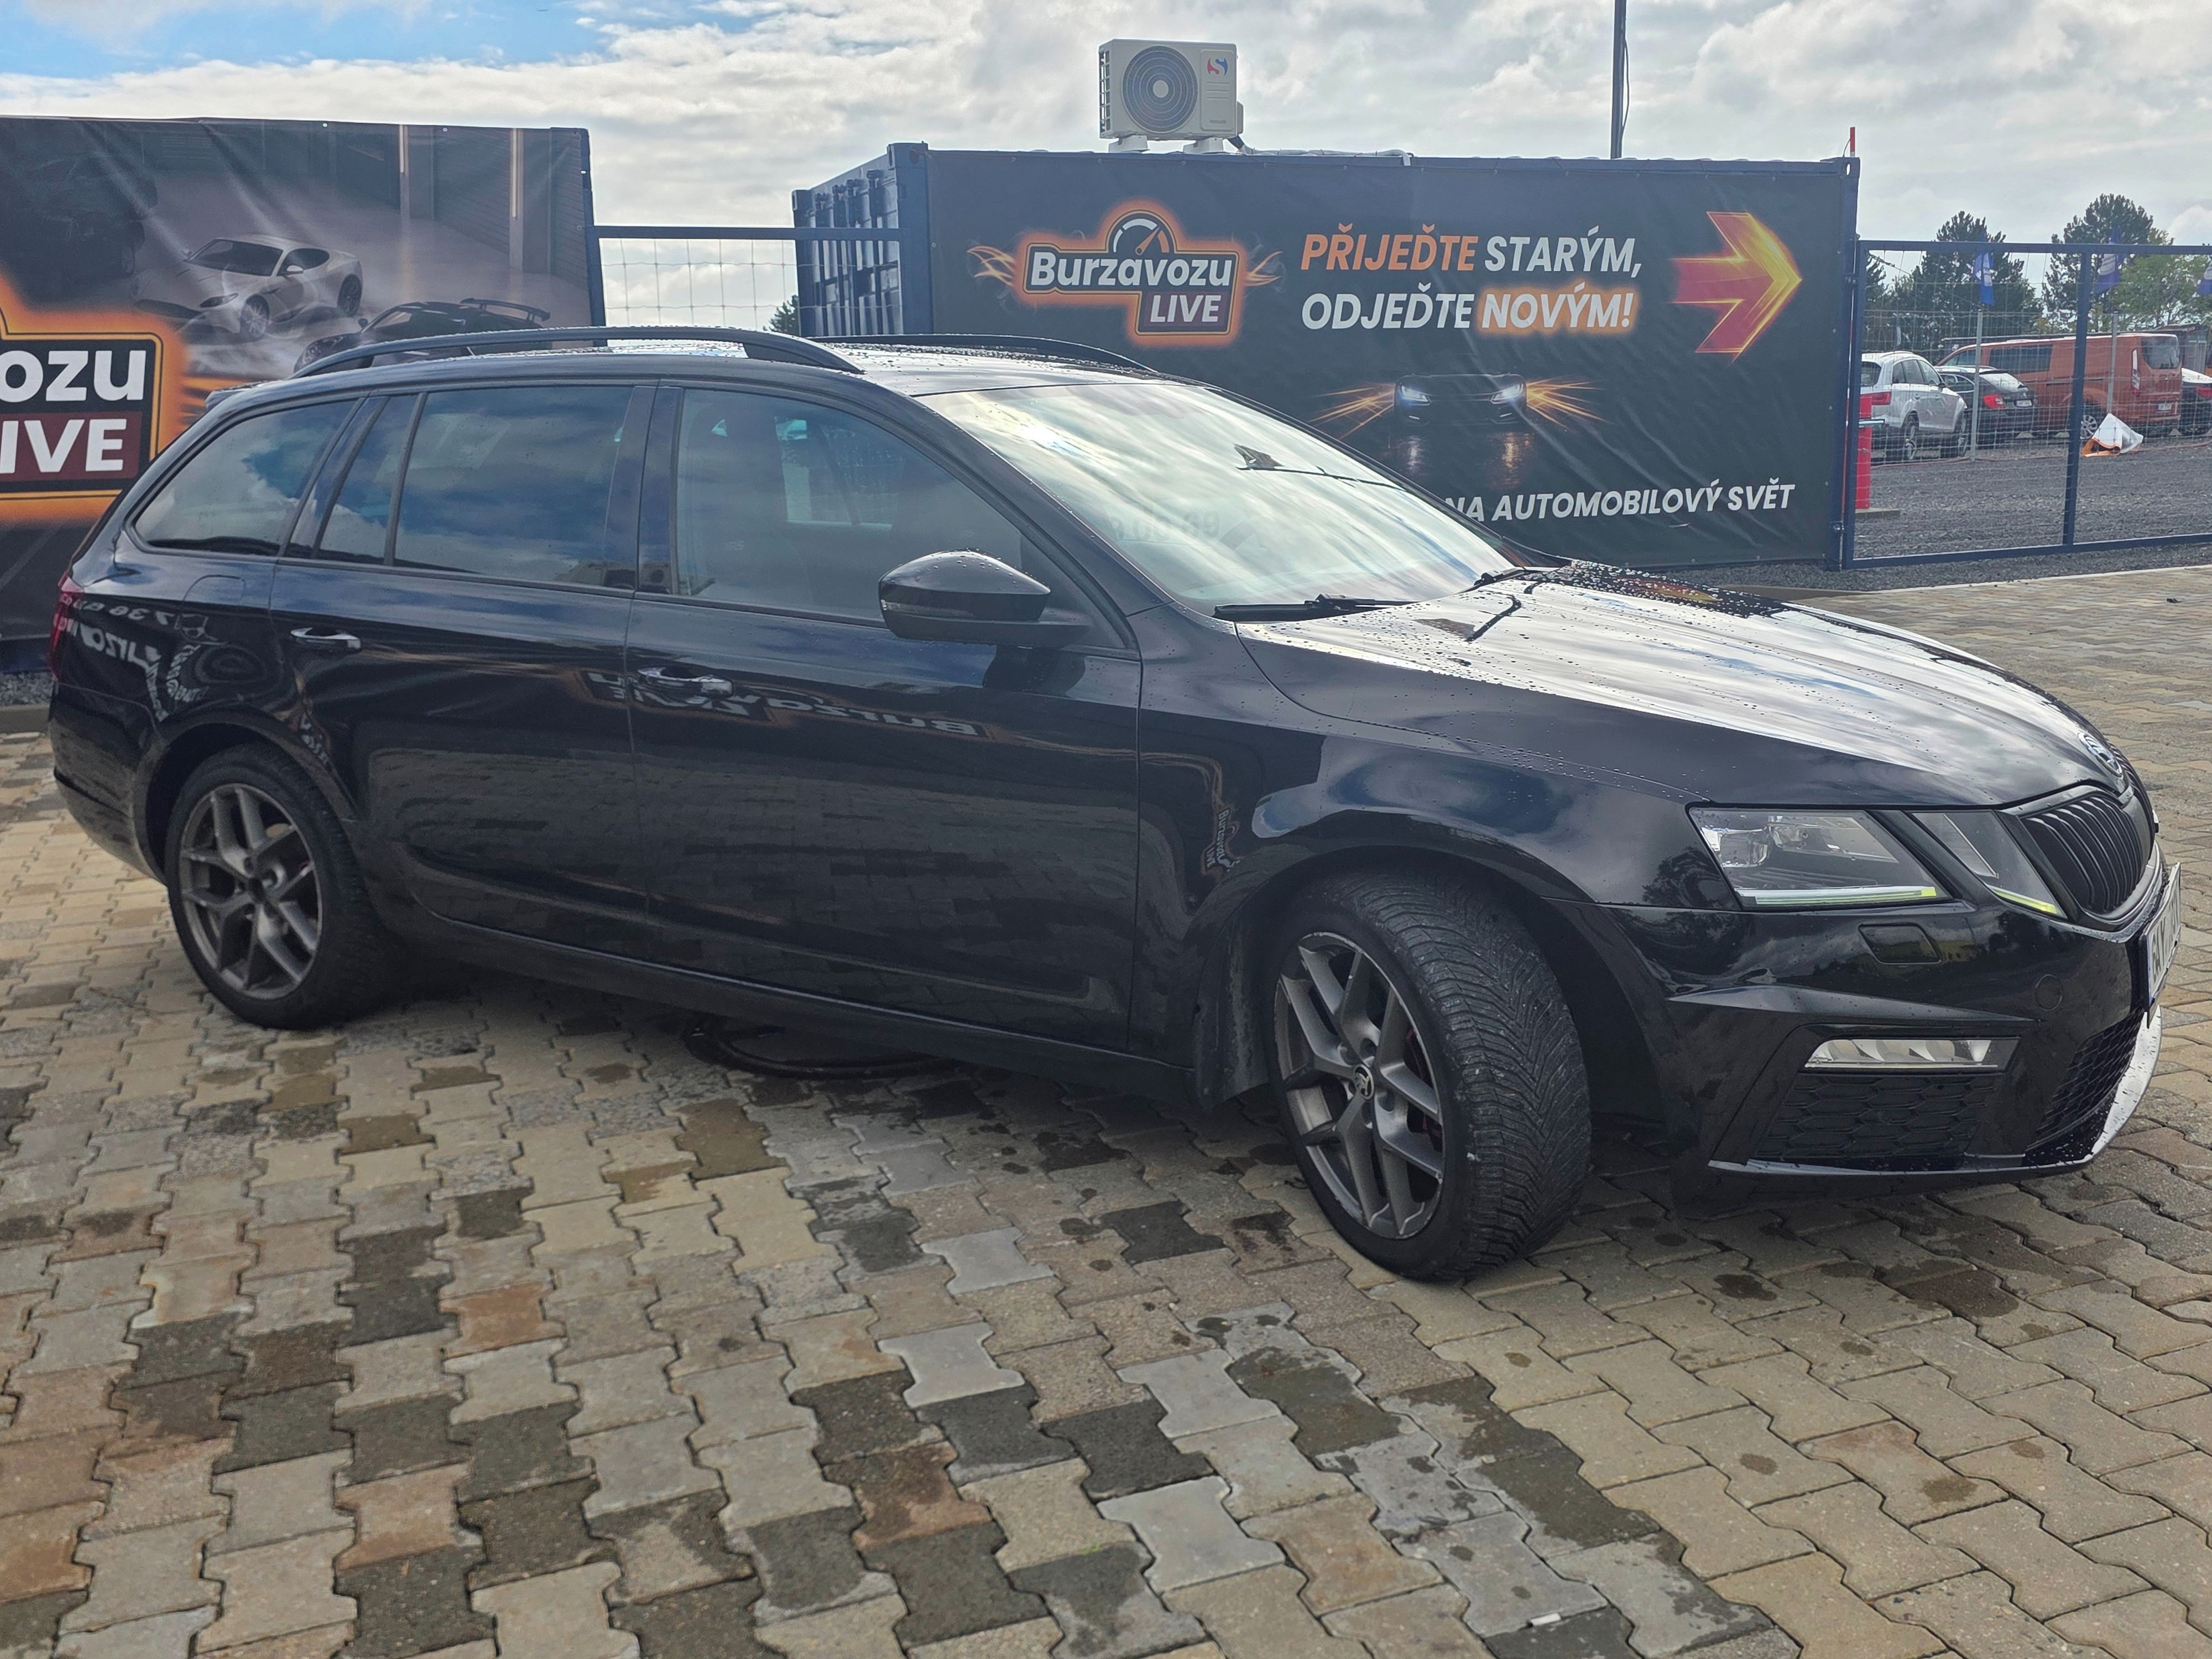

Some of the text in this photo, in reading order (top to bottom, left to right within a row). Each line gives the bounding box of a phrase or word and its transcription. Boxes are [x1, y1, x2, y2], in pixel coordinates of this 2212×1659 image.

[1031, 252, 1232, 286] Burzavozu
[1301, 223, 1642, 278] PŘIJEĎTE STARÝM,
[1150, 294, 1222, 323] LIVE
[1301, 281, 1634, 330] ODJEĎTE NOVÝM!
[1492, 479, 1723, 521] AUTOMOBILOVÝ
[1728, 477, 1796, 511] SVĚT
